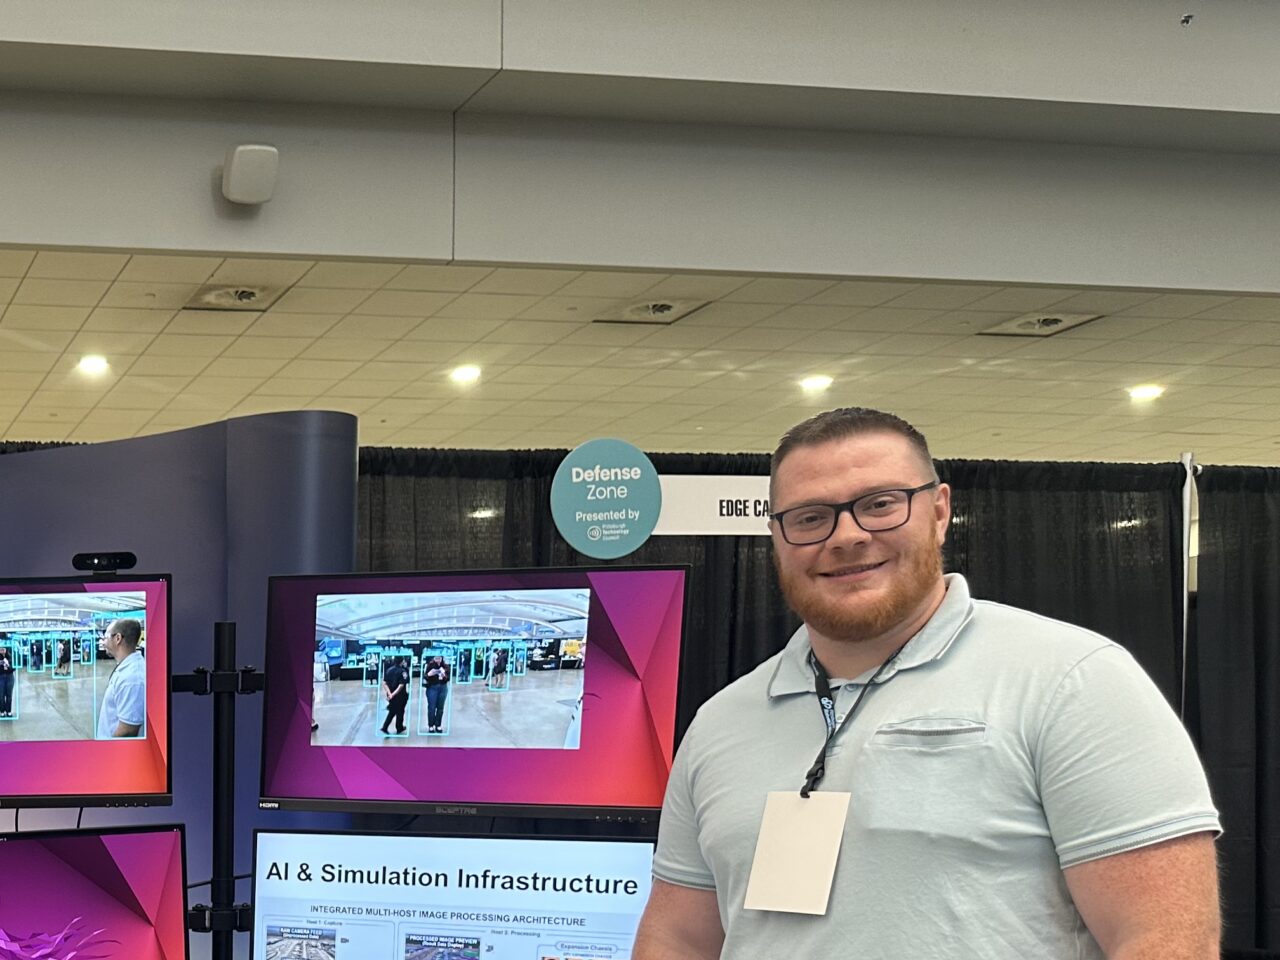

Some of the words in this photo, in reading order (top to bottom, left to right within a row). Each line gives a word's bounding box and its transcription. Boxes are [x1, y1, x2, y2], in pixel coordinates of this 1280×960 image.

[571, 465, 641, 483] Defense
[586, 484, 628, 500] Zone
[575, 510, 627, 522] Presented
[629, 508, 640, 521] by
[719, 499, 749, 518] EDGE
[265, 861, 289, 881] AI
[296, 863, 313, 882] &
[320, 863, 449, 887] Simulation
[457, 868, 639, 895] Infrastructure
[310, 905, 363, 915] INTEGRATED
[365, 908, 417, 918] MULTI-HOST
[419, 909, 448, 920] IMAGE
[450, 911, 510, 922] PROCESSING
[512, 914, 587, 927] ARCHITECTURE
